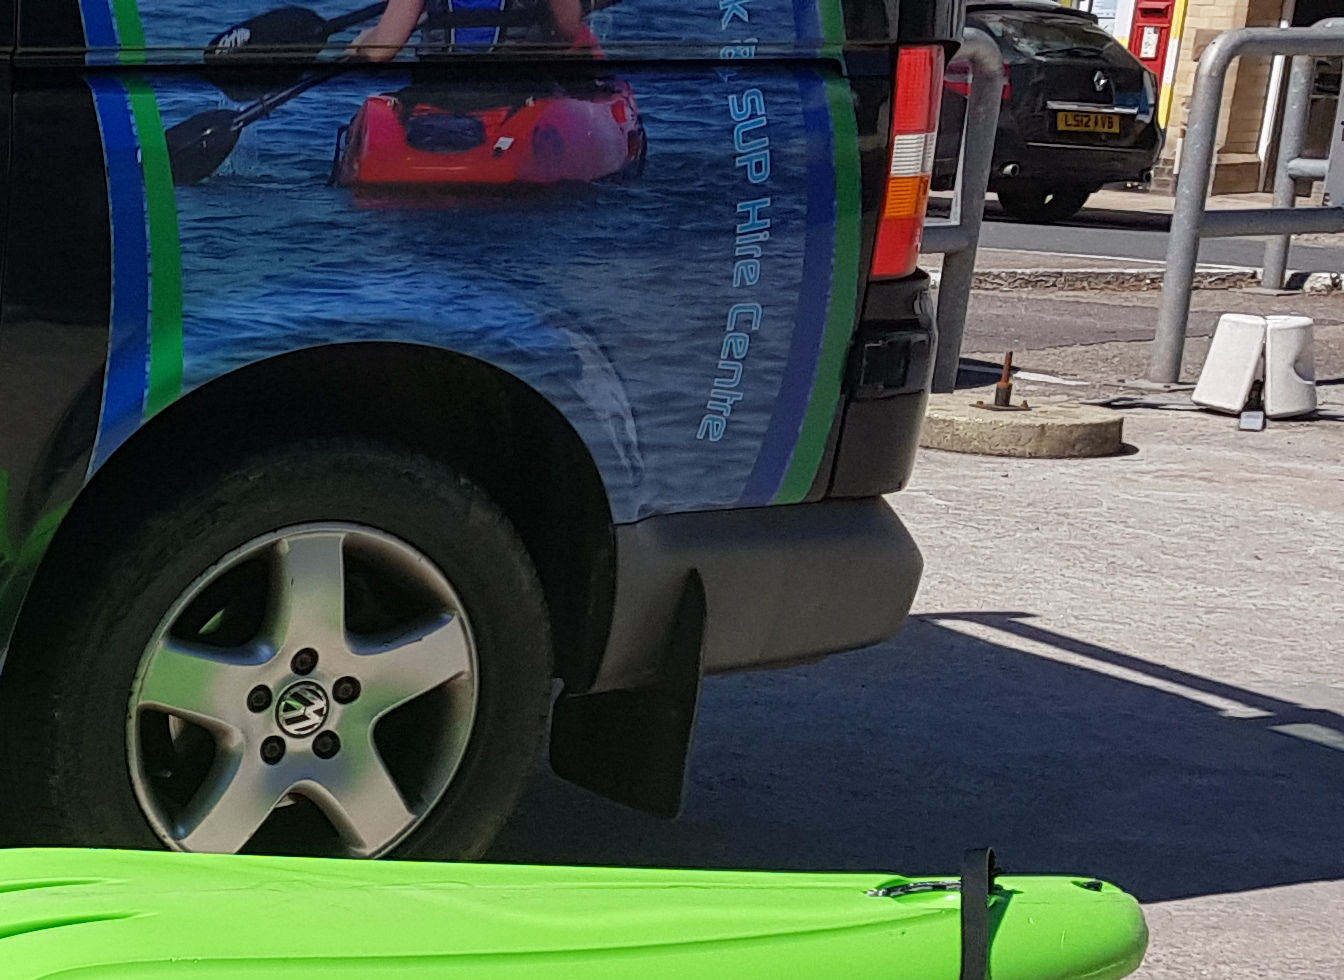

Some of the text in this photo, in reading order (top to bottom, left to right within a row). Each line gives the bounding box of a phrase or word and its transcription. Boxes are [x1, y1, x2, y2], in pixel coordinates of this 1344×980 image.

[728, 88, 772, 183] SUP
[733, 198, 772, 288] Hire
[696, 302, 763, 442] Centre
